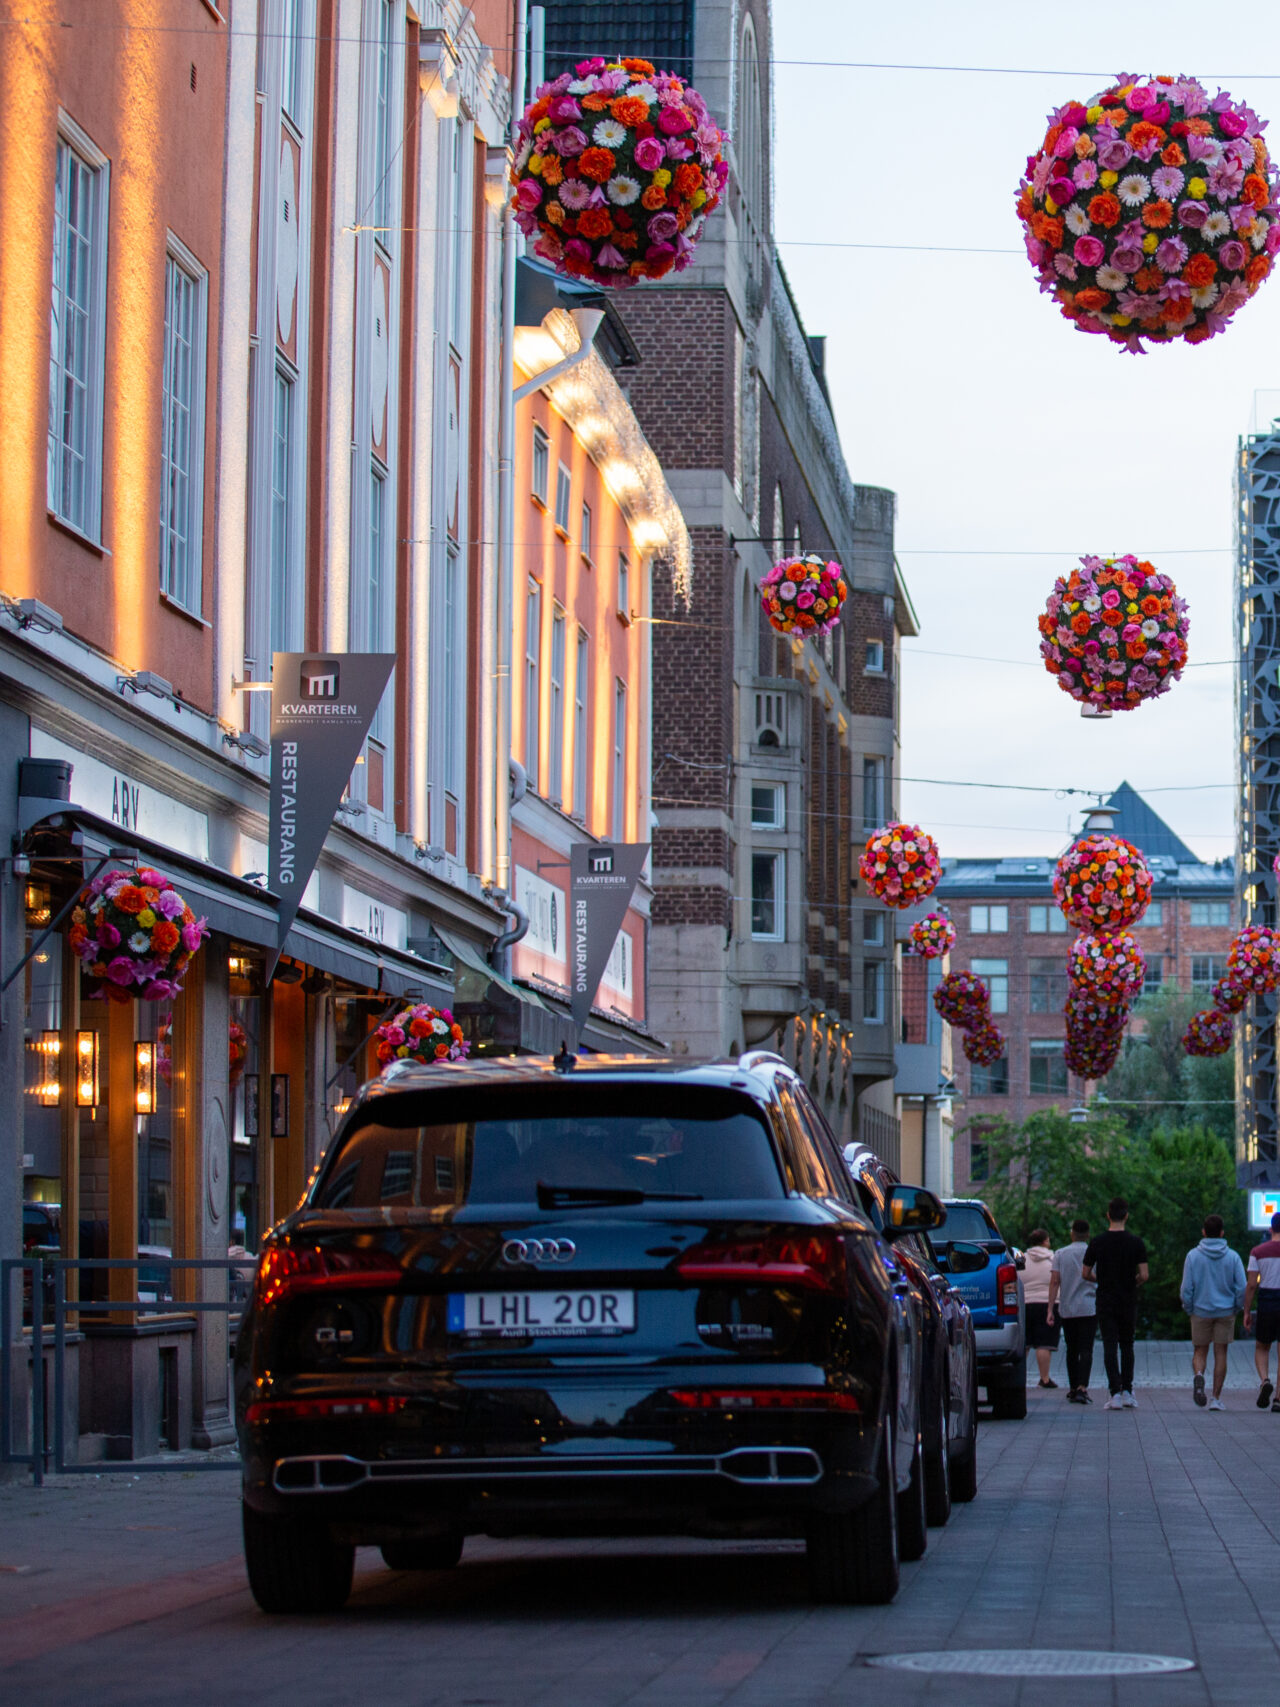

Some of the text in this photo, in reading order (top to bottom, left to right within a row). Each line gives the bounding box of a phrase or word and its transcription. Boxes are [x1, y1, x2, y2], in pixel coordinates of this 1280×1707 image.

[281, 704, 357, 715] KVARTEREN
[112, 775, 140, 832] ARV
[279, 742, 298, 884] RESTAURANG
[576, 876, 626, 884] KVARTEREN
[369, 904, 385, 942] ARV
[576, 900, 587, 993] RESTAURANG
[479, 1294, 619, 1325] LHL 20R
[500, 1327, 587, 1337] Audi Stockholm
